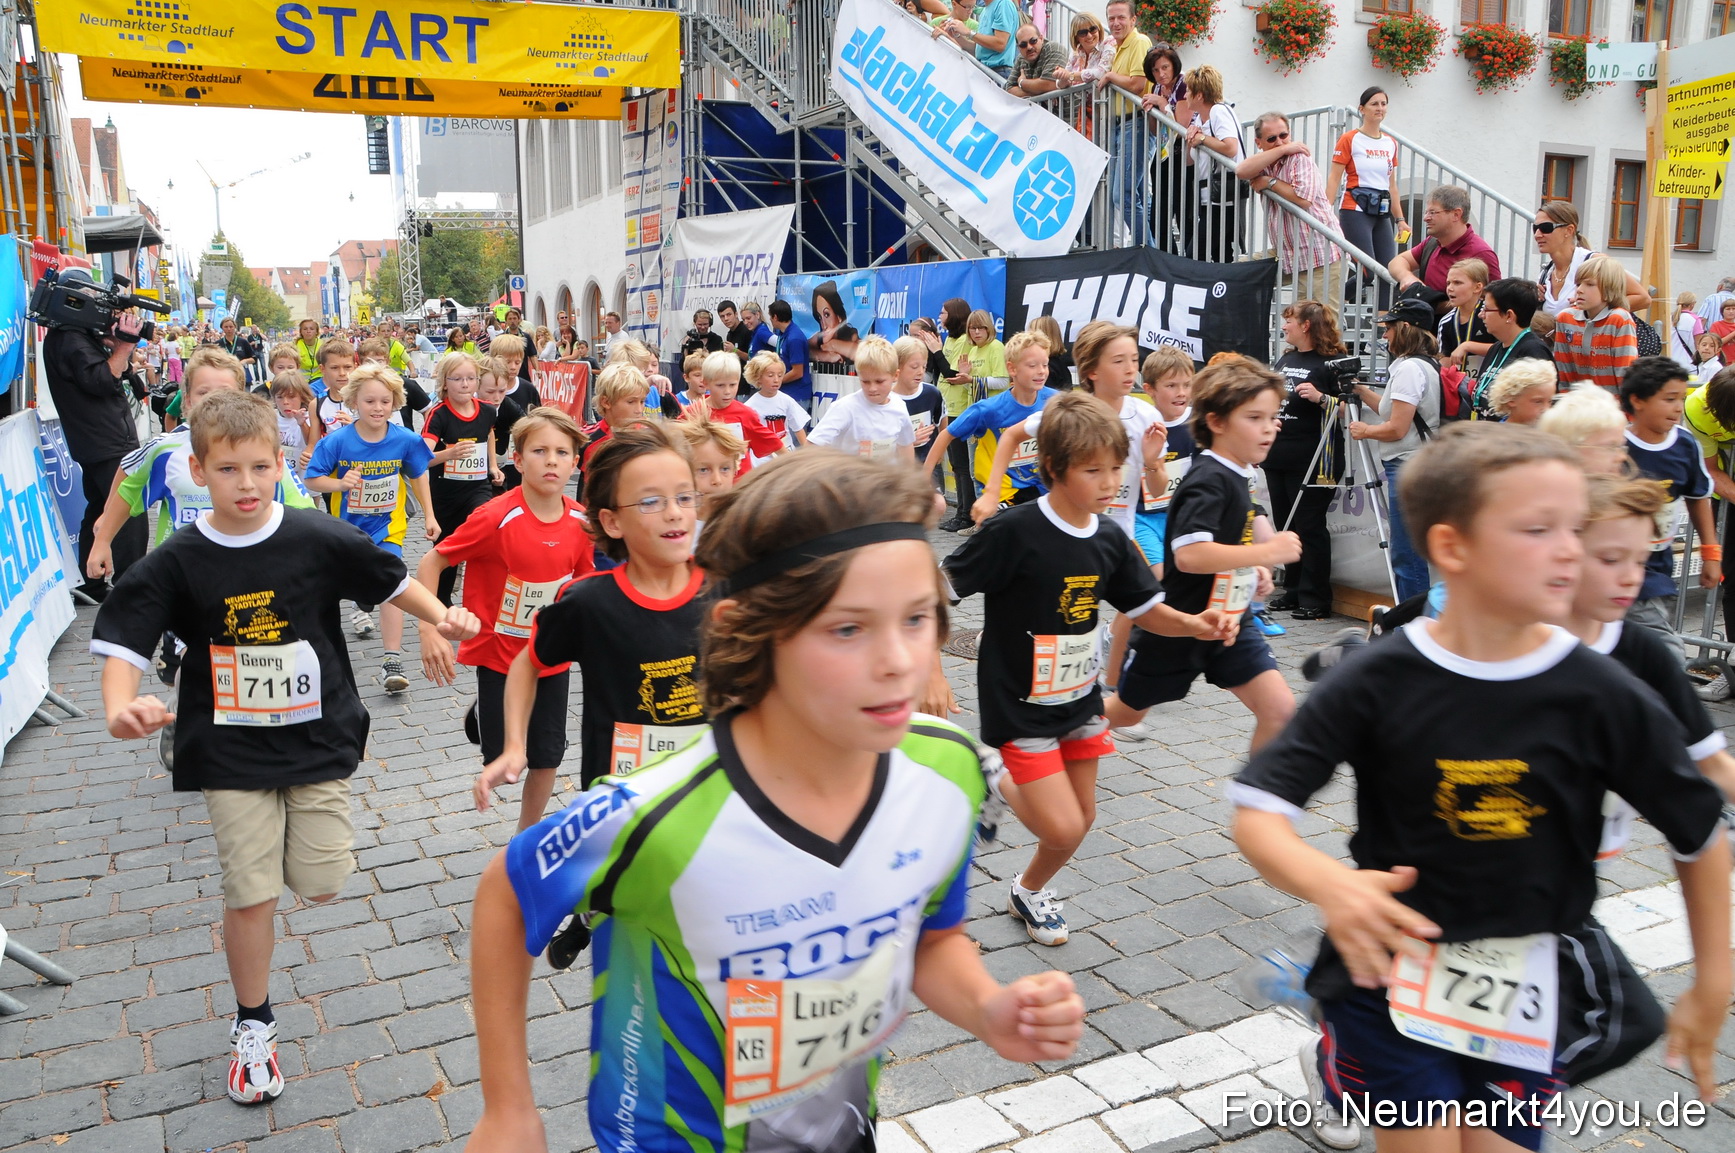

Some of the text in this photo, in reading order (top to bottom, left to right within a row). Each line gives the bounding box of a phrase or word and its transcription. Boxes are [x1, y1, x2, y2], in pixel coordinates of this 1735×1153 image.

[79, 12, 235, 39] Neumarkter Stadtlauf
[274, 2, 490, 64] START
[527, 47, 649, 63] Neumarkter Stadtlauf
[112, 66, 243, 85] Neumarkter Stadtlauf
[498, 87, 602, 99] Neumarkter Stadtlauf
[1686, 123, 1730, 140] ausgabe
[1668, 163, 1706, 178] Kinder-
[1658, 180, 1711, 199] betreuung
[687, 252, 775, 290] PFLEIDERER
[877, 285, 909, 319] maxi
[1021, 273, 1208, 363] THULE
[1145, 330, 1195, 354] SWEDEN
[459, 457, 485, 469] 7098
[364, 480, 392, 490] Benedikt
[364, 490, 395, 503] 7028
[224, 590, 275, 605] NEUMARKTER
[525, 587, 543, 598] Leo
[230, 598, 271, 611] STADTLAUF
[237, 620, 289, 635] BAMBINILAUF
[241, 653, 283, 671] Georg
[639, 655, 697, 671] NEUMARKTER
[645, 664, 694, 679] STADTLAUF
[244, 673, 311, 699] 7118
[726, 891, 837, 935] TEAM
[1443, 965, 1542, 1021] 7273
